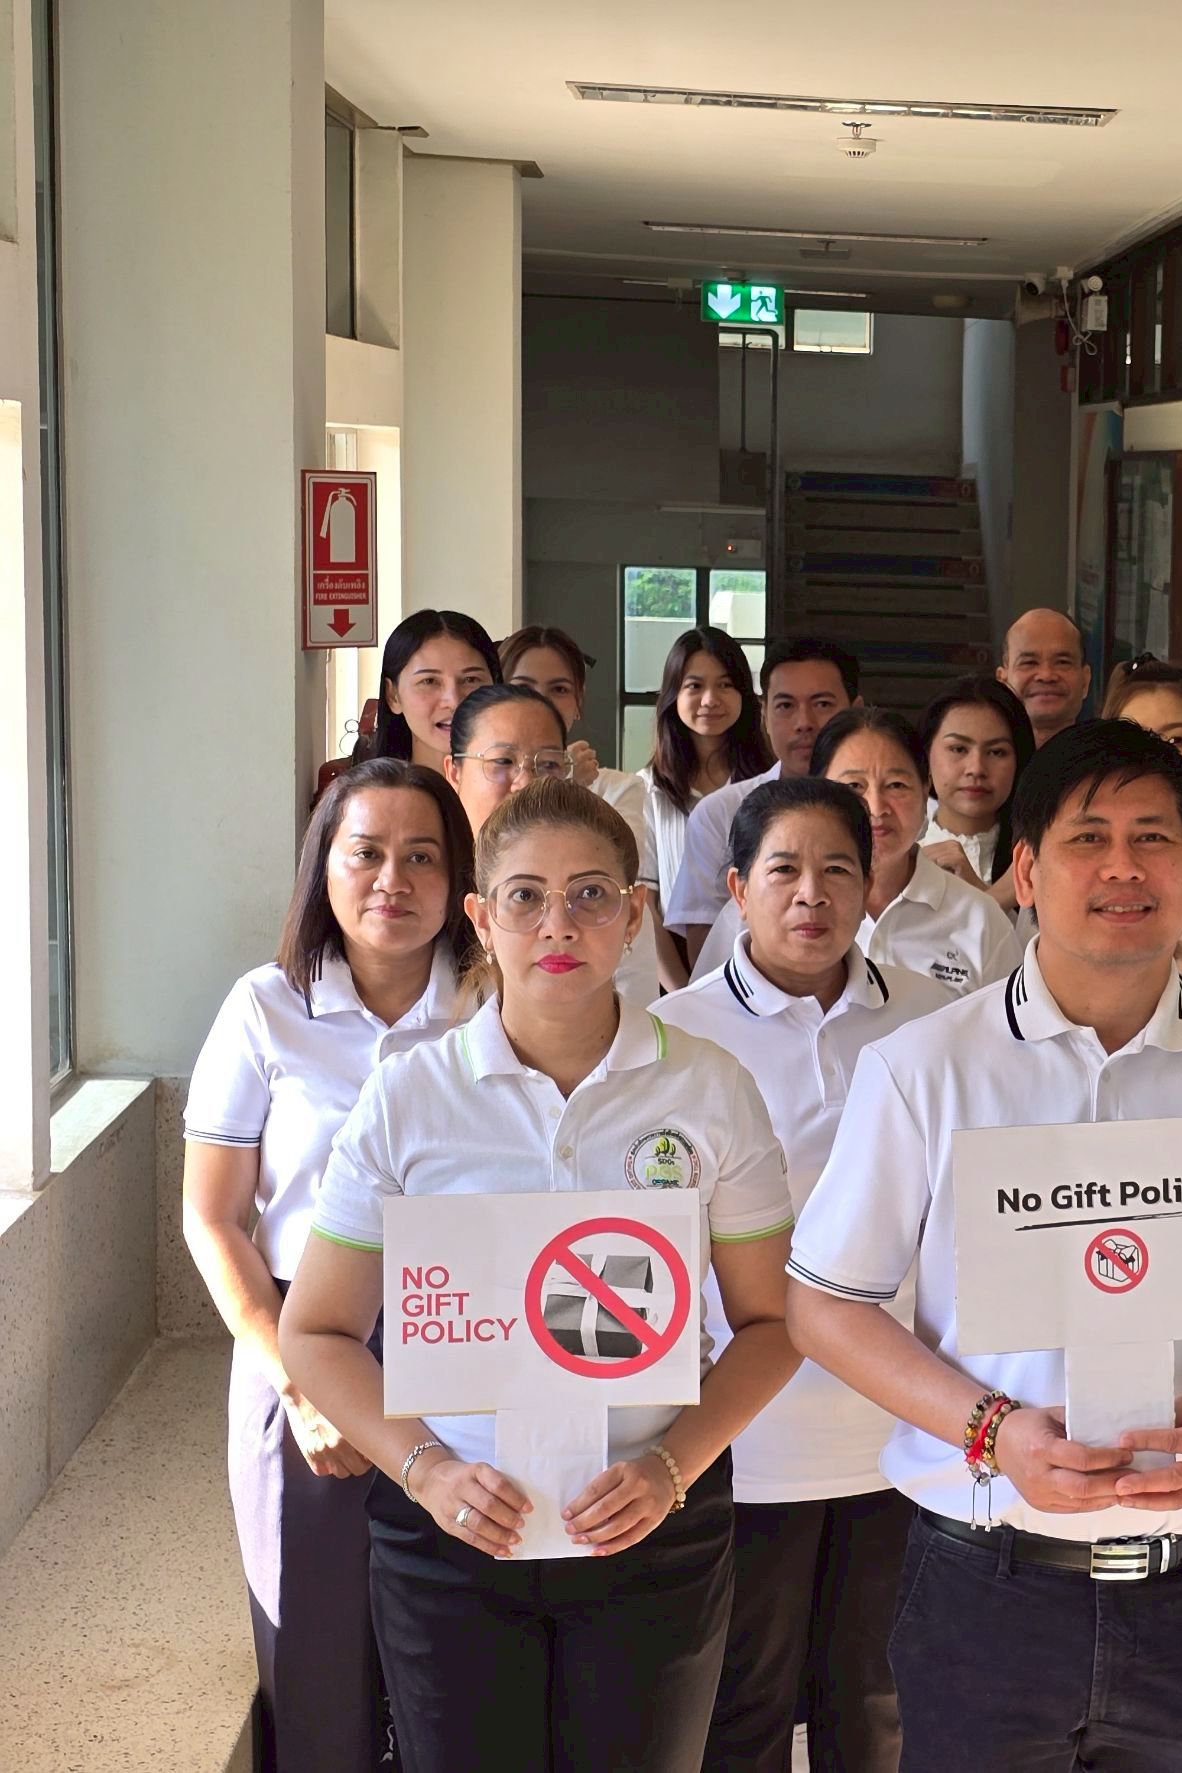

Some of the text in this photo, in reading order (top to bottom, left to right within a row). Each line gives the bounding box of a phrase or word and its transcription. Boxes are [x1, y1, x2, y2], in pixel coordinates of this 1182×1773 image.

[997, 1188, 1042, 1213] No
[1050, 1182, 1111, 1209] Gift
[402, 1265, 450, 1290] NO
[401, 1292, 470, 1318] GIFT
[402, 1317, 518, 1345] POLICY
